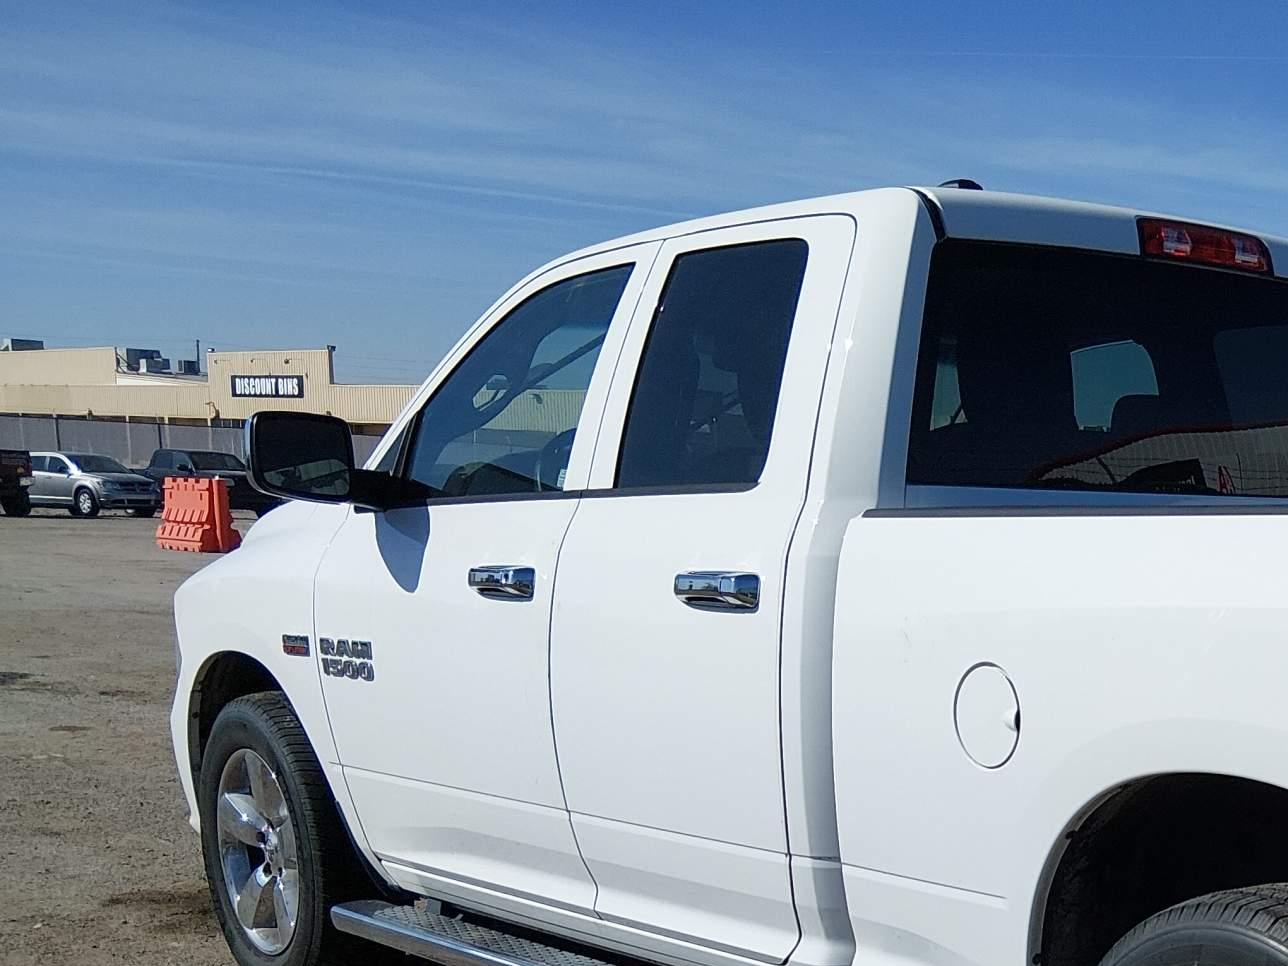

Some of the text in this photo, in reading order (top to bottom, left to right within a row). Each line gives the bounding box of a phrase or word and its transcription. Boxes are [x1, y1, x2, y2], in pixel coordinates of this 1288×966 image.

[235, 377, 299, 395] DISCOUNT BINS
[319, 637, 373, 660] RAM
[321, 658, 375, 681] 1500
